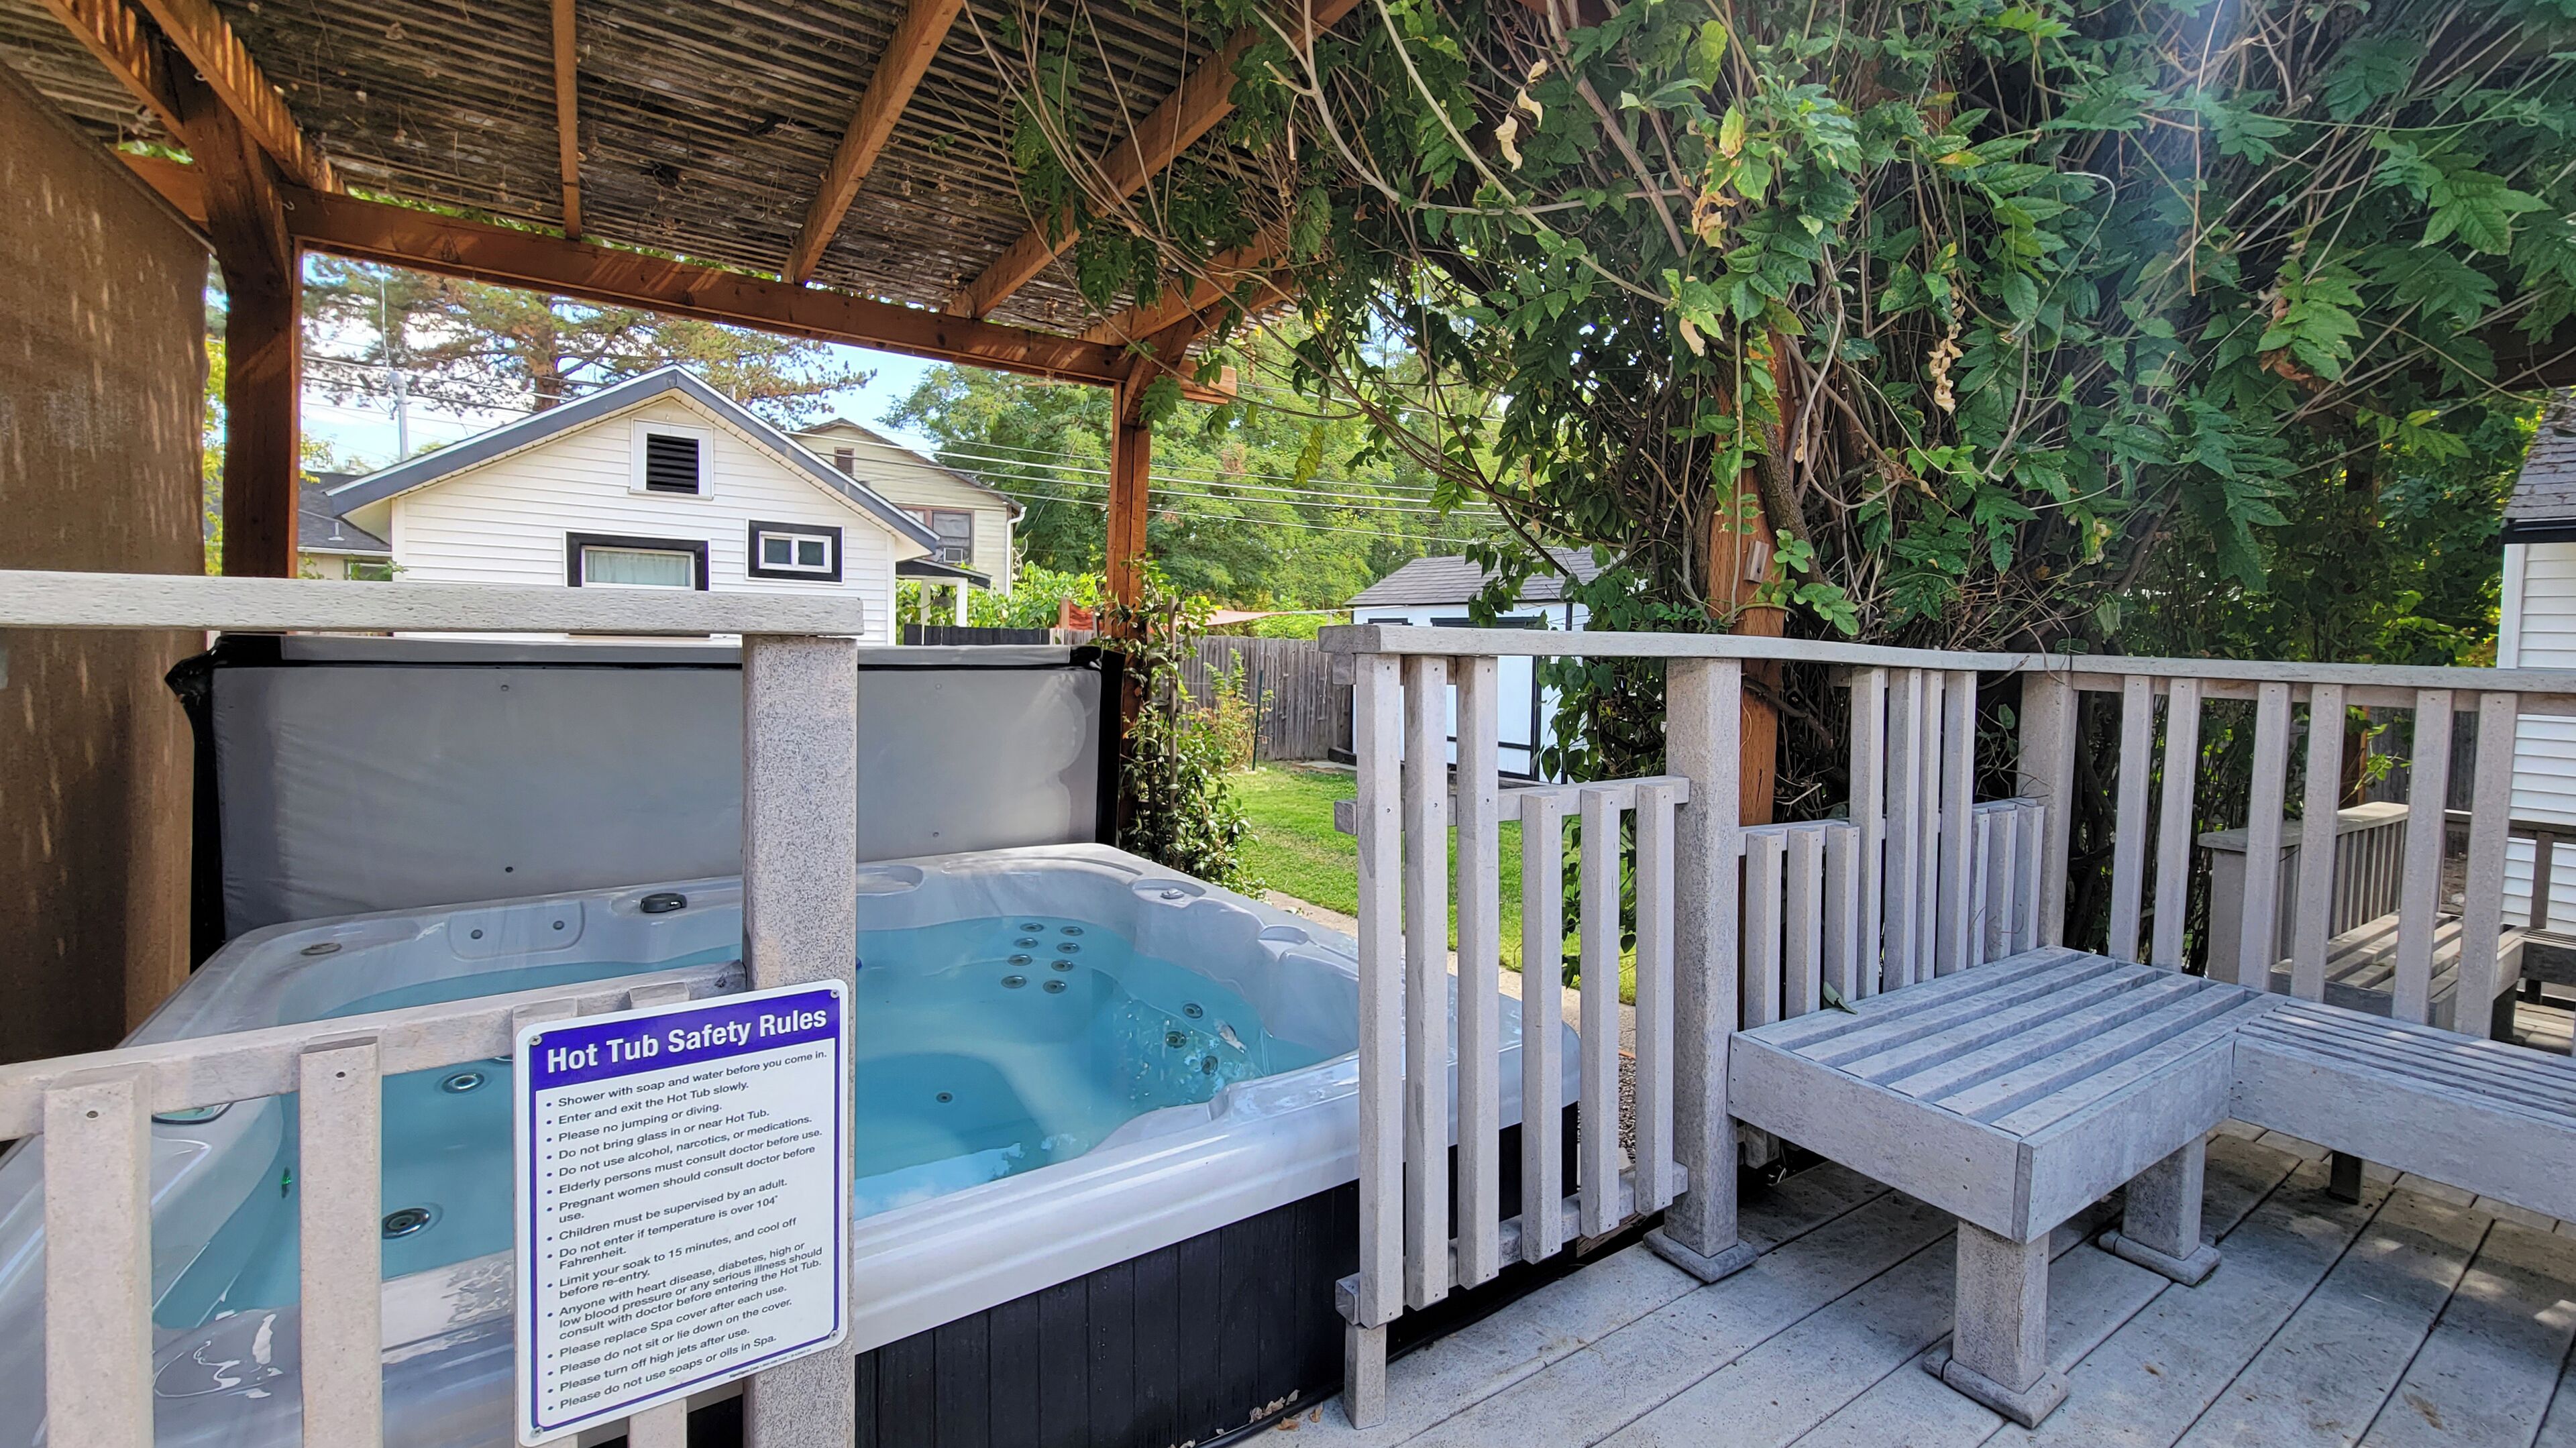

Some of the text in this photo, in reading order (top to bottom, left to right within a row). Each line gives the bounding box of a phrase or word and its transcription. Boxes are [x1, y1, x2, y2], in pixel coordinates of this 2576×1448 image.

[547, 1009, 826, 1073] Hot Tub Safety Rules
[557, 1050, 827, 1107] Shower with soap and water before you come in.
[558, 1080, 749, 1125] Enter and exit the Hot Tub slowly.
[558, 1103, 722, 1142] Please no jumping or diving.
[558, 1108, 769, 1160] Do not bring glass in or near Hot Tub.
[558, 1116, 812, 1177] Do not use alcohol, narcotics, or medications.
[558, 1129, 822, 1194] Elderly persons must consult doctor before use.
[558, 1146, 816, 1212] Pregnant women should consult doctor before
[558, 1178, 788, 1240] Children must be supervised by an adult.
[558, 1212, 584, 1223] use.
[559, 1247, 577, 1258] Do
[580, 1240, 600, 1253] not
[602, 1232, 635, 1247] enter
[637, 1228, 645, 1239] if
[647, 1213, 716, 1236] temperature
[718, 1209, 728, 1218] is
[729, 1203, 755, 1215] over
[558, 1241, 805, 1317] Anyone with heart disease, diabetes, high or
[559, 1216, 797, 1287] Limit your soak to 15 minutes, and cool off
[559, 1246, 627, 1270] Fahrenheit.
[559, 1269, 650, 1299] before re-entry.
[559, 1246, 822, 1329] low blood pressure or any serious illness should
[559, 1259, 822, 1340] consult with doctor before entering the Hot Tub.
[559, 1285, 787, 1357] Please replace Spa cover after each use.
[559, 1298, 792, 1375] Please do not sit or lie down on the cover.
[559, 1328, 750, 1392] Please turn off high jets after use.
[559, 1335, 777, 1409] Please do not use soaps or oils in Spa.
